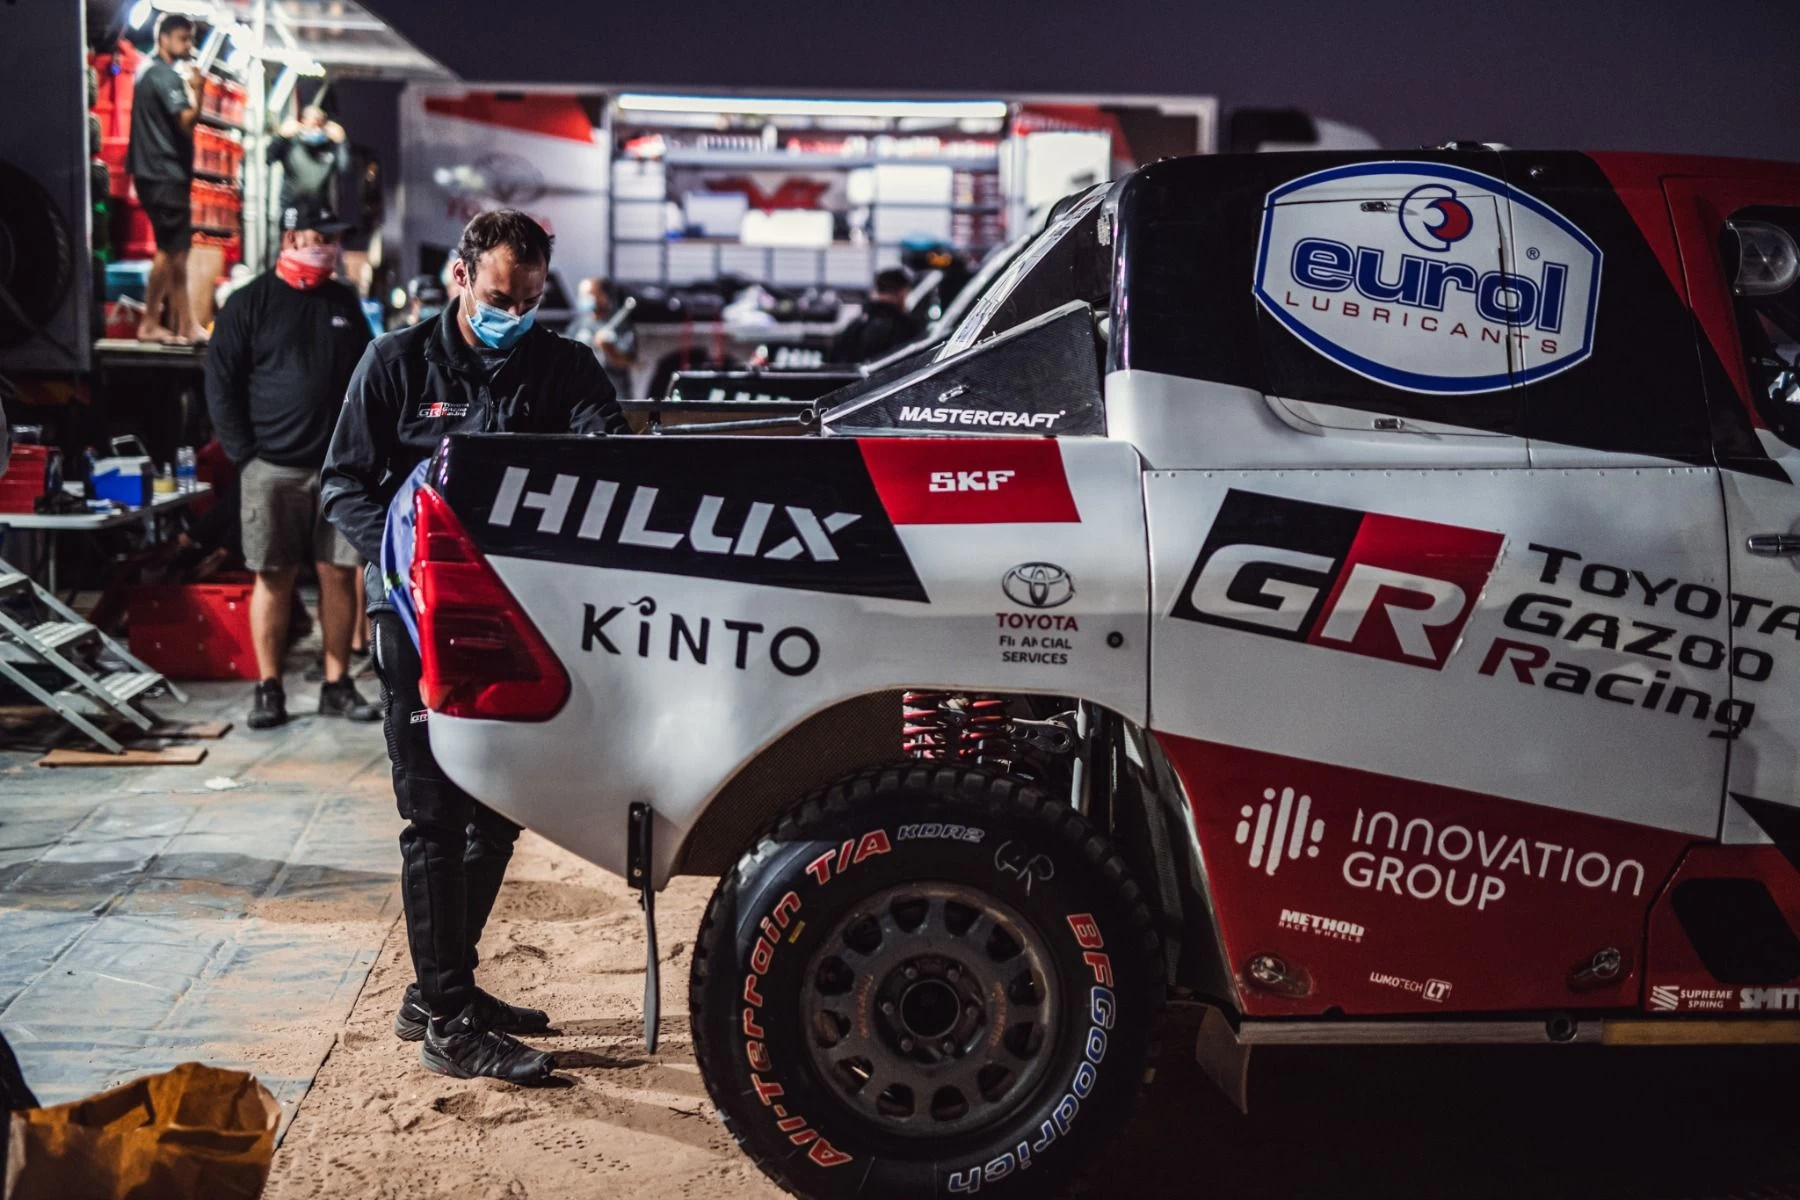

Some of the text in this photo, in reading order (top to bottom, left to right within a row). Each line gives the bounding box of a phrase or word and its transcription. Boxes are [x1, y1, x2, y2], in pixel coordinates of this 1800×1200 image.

[1291, 237, 1569, 333] eurol
[1285, 290, 1559, 355] LUBRICANTS
[900, 406, 1059, 428] MASTERCRAFT
[929, 470, 1016, 492] SKF
[488, 465, 863, 563] HILUX
[1191, 543, 1466, 662] GR
[1528, 542, 1800, 641] TOYOTA
[996, 613, 1079, 632] TOYOTA
[1503, 592, 1774, 681] GAZOO
[1002, 651, 1068, 665] SERVICES
[1478, 637, 1755, 740] Racing
[806, 829, 891, 886] T/A
[1343, 851, 1506, 910] GROUP
[1281, 909, 1365, 937] METHOD
[1680, 989, 1734, 1000] SUPREME
[1687, 1000, 1724, 1009] SPRING
[1740, 987, 1800, 1010] SMIT
[744, 891, 853, 1167] All-Terrain
[948, 912, 1116, 1194] BFGoodrich
